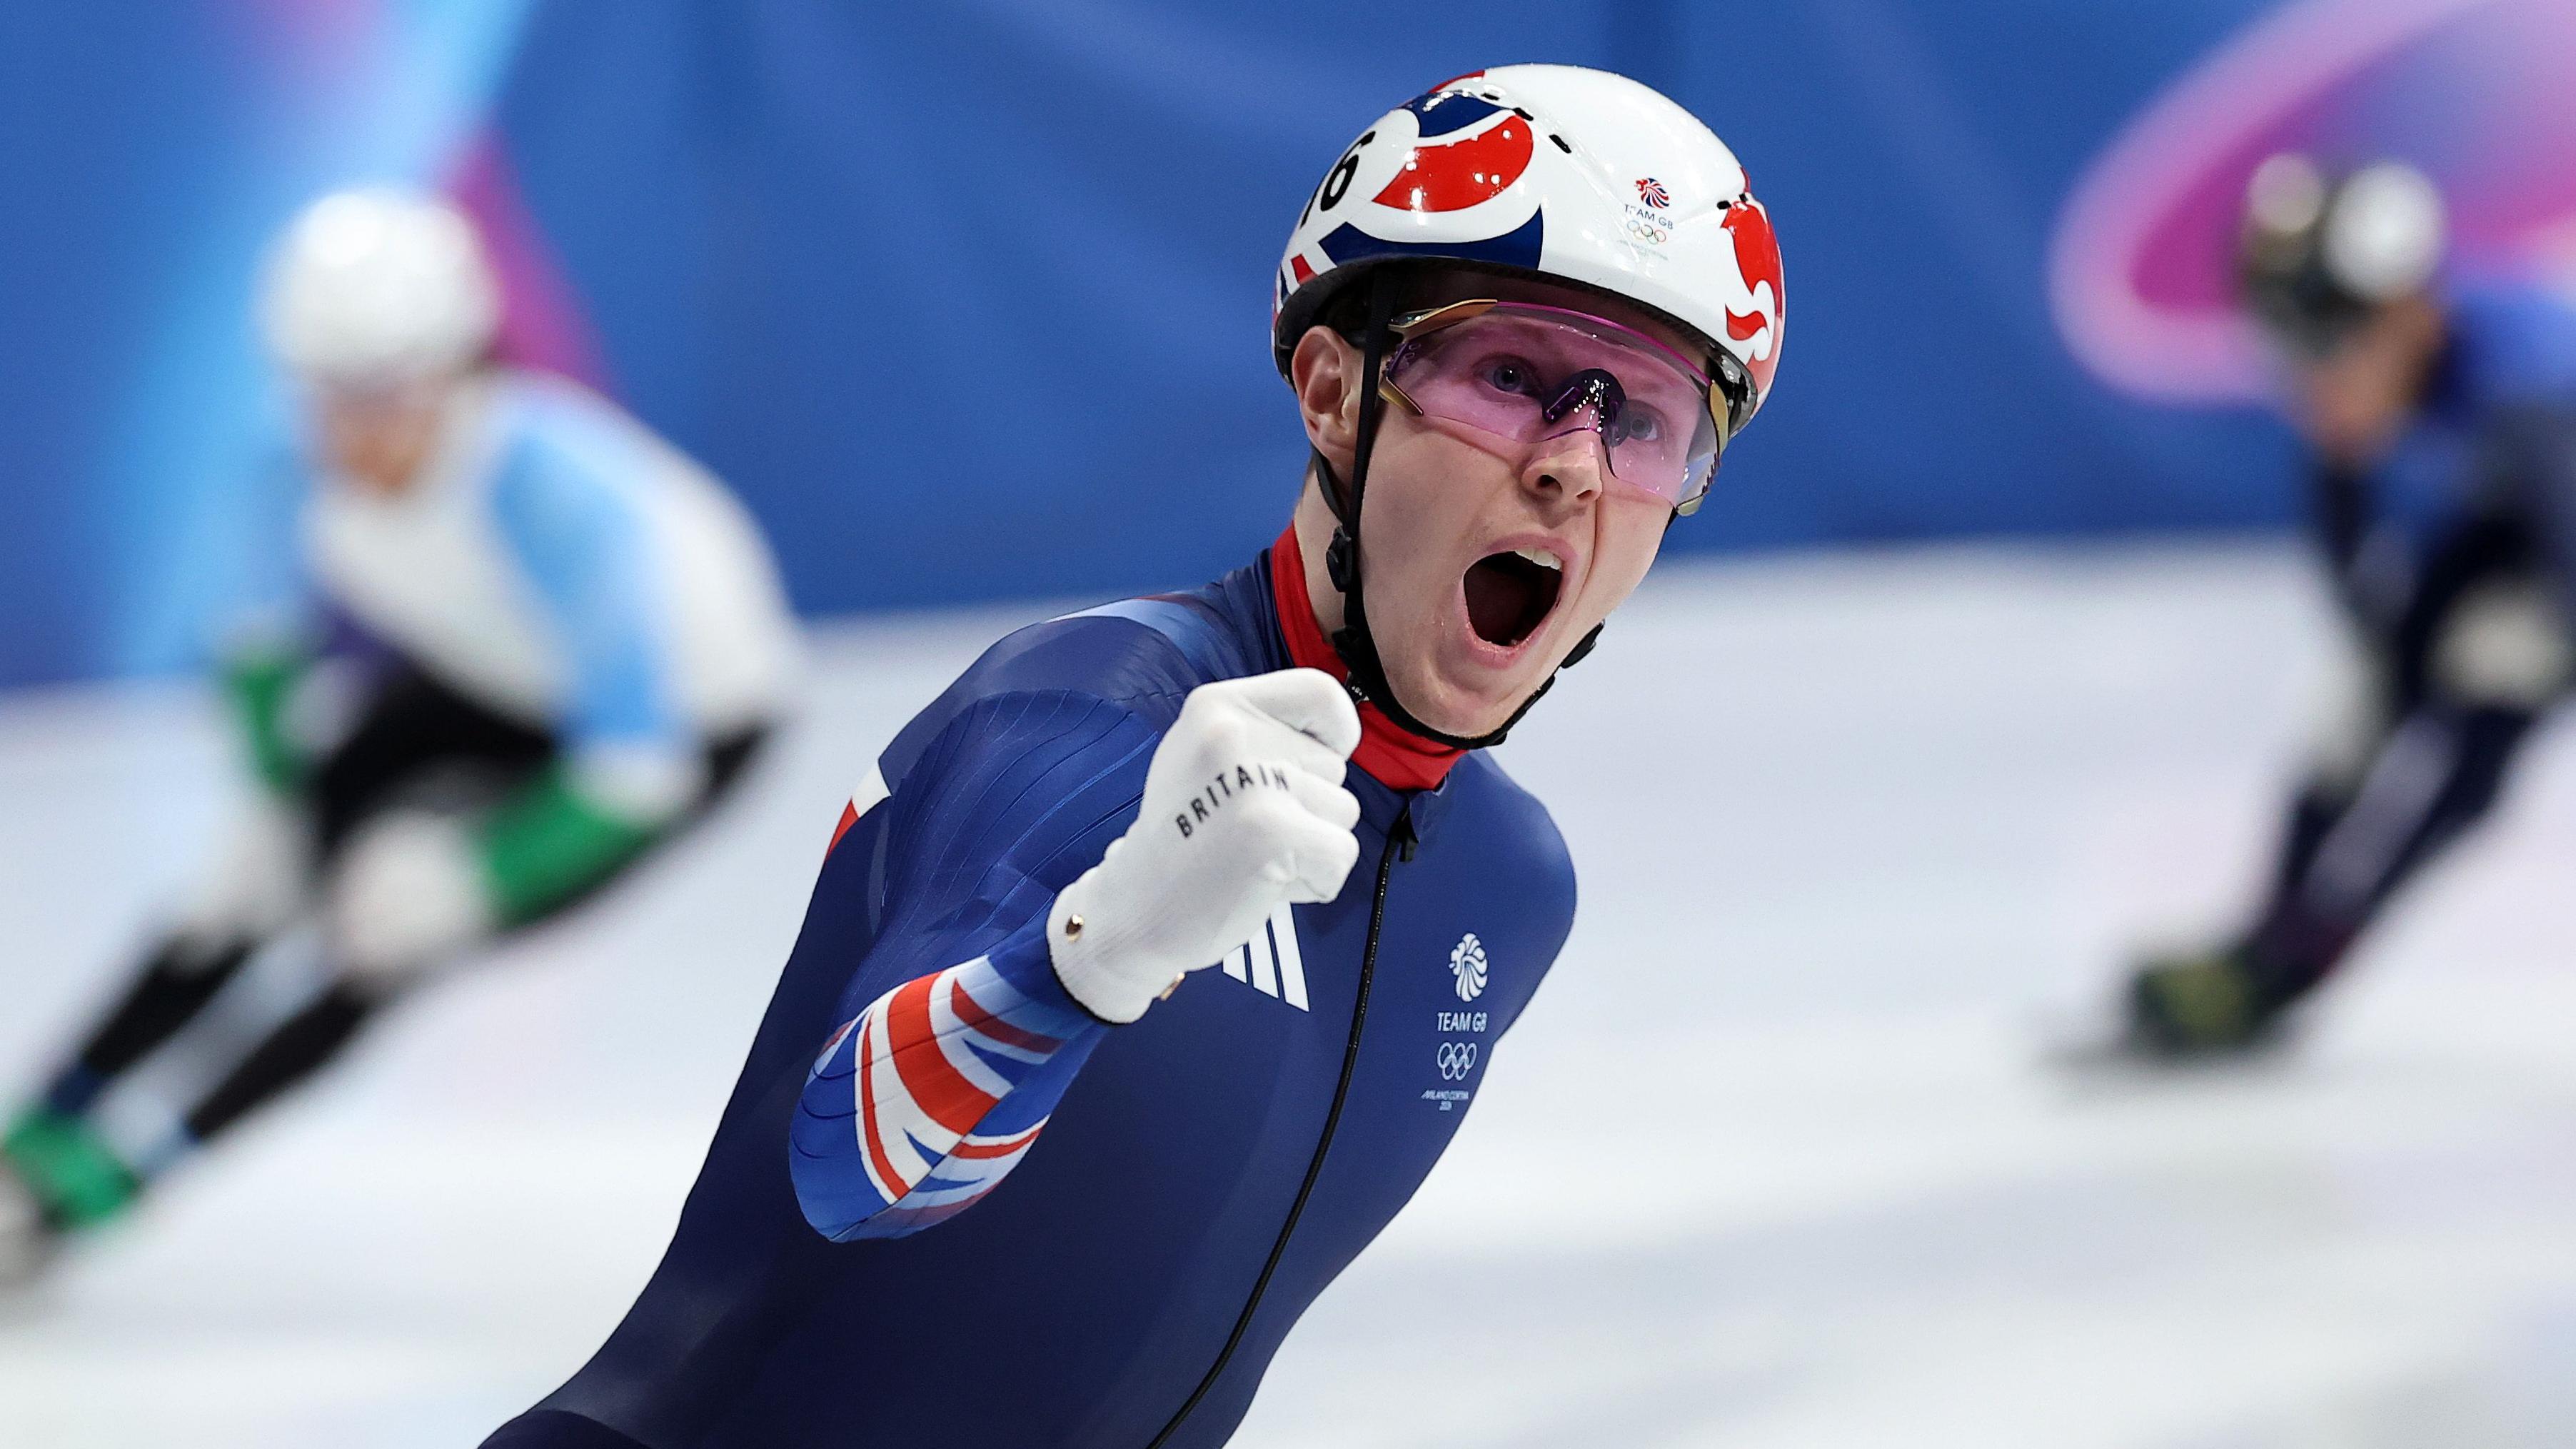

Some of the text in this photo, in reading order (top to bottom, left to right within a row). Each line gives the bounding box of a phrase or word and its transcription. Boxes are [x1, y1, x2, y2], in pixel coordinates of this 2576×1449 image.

[1659, 217, 1674, 229] GB
[1176, 763, 1289, 838] BRITAIN
[1437, 1012, 1487, 1033] TEAM GB
